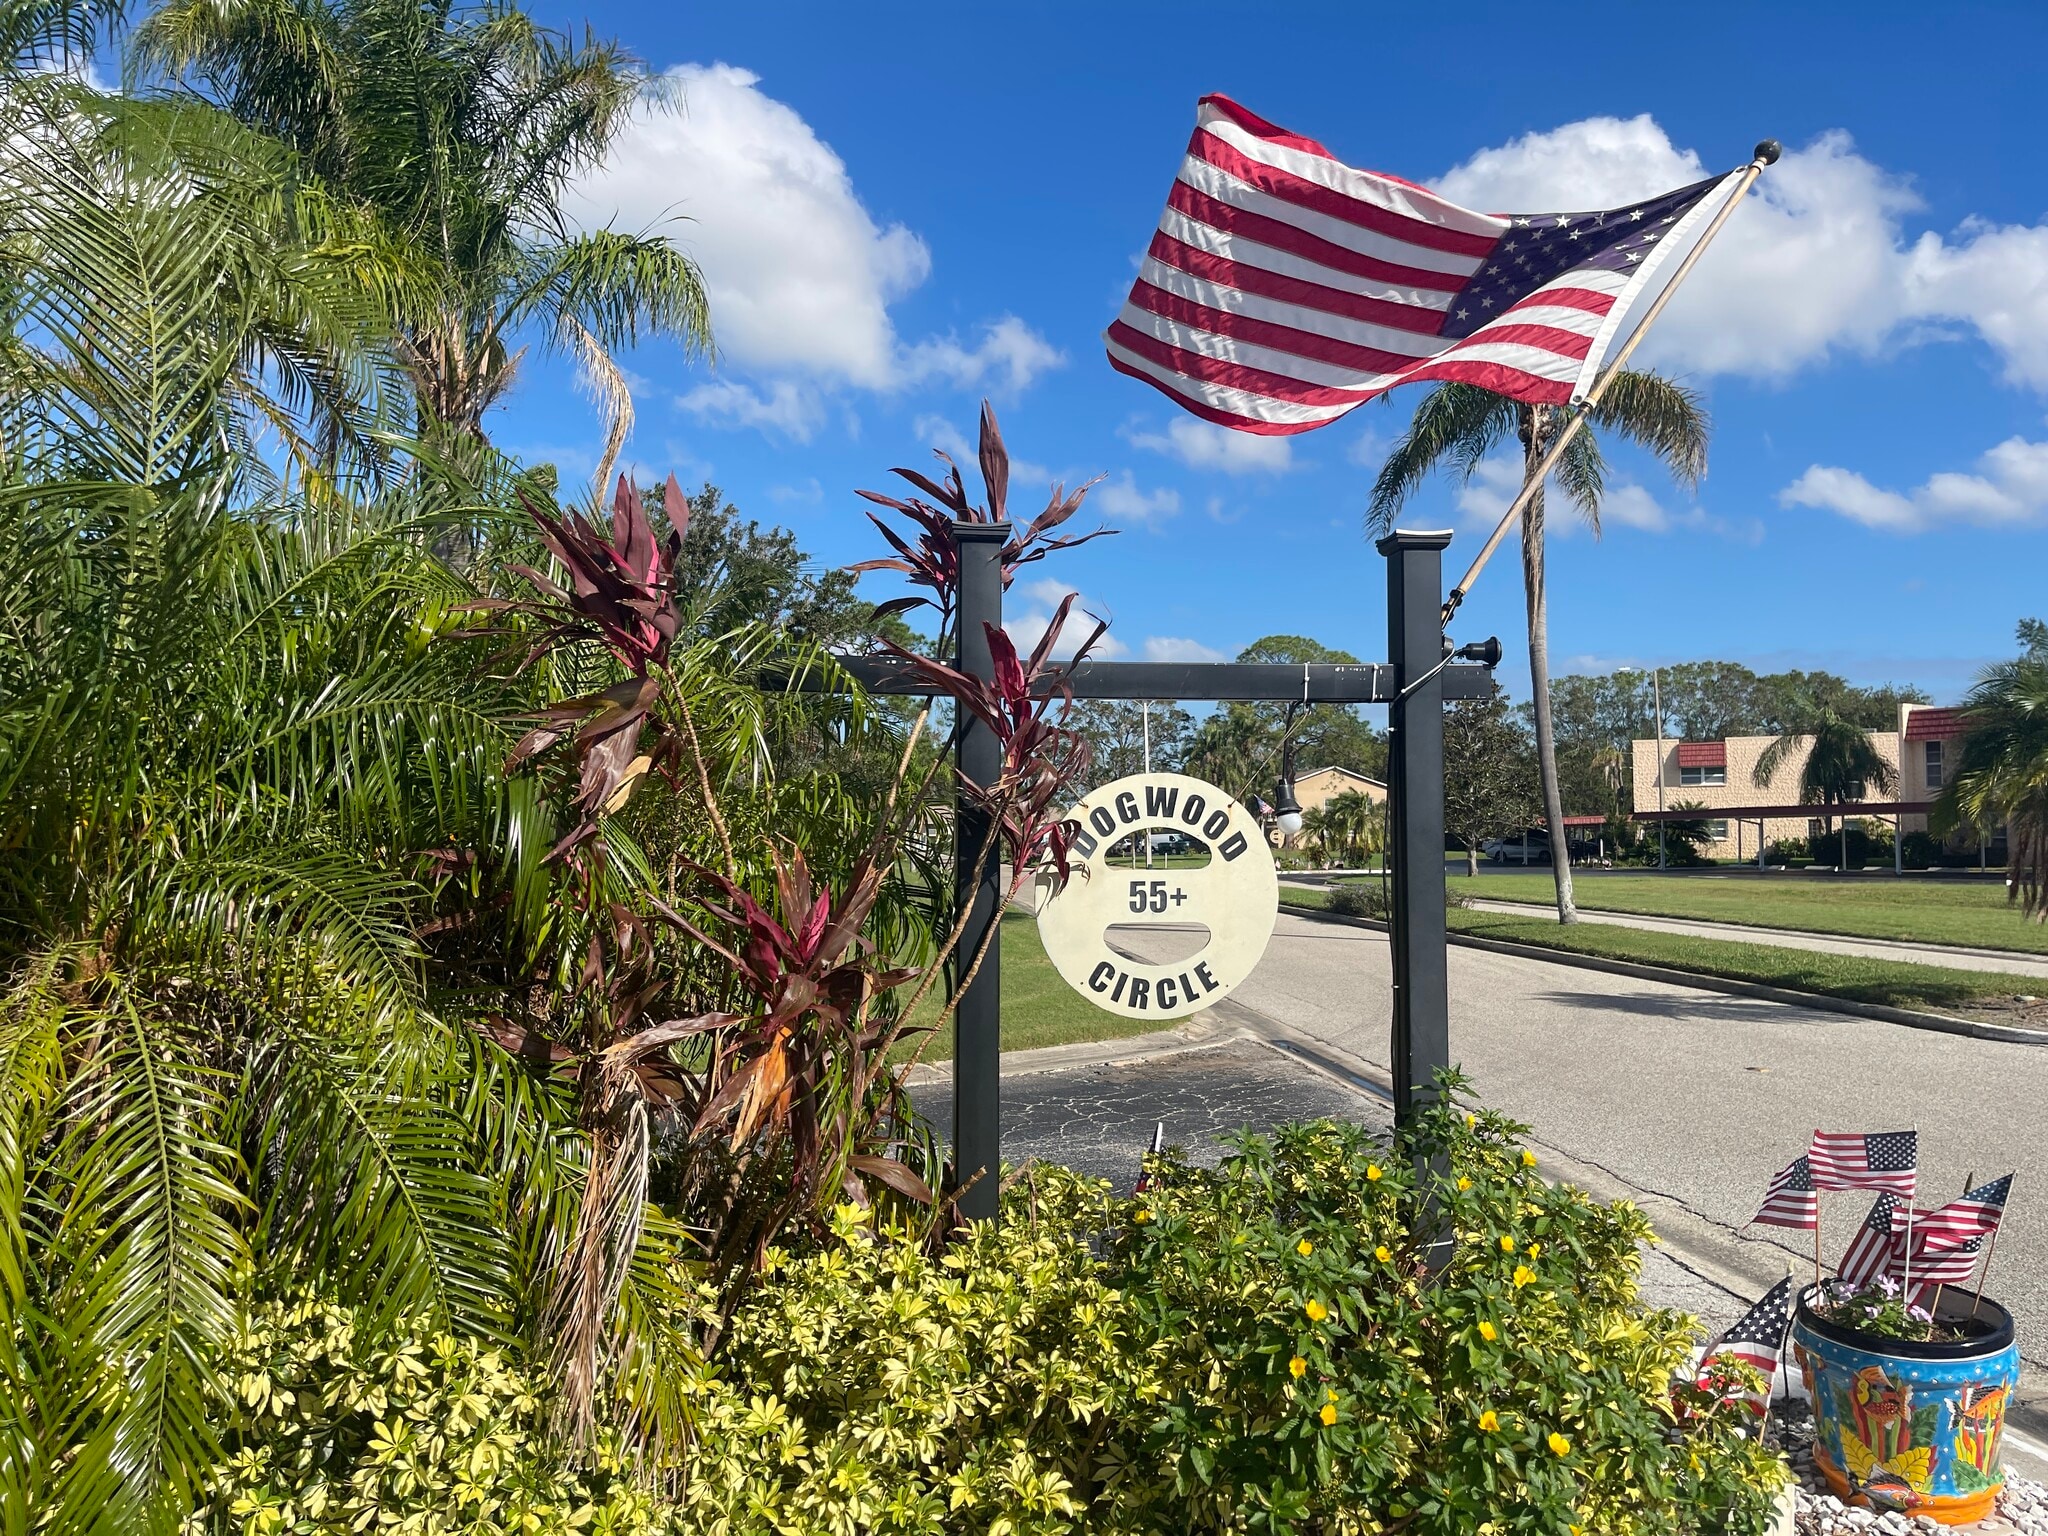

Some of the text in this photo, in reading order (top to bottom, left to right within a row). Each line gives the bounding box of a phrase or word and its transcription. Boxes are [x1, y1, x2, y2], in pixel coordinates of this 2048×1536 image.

[1072, 786, 1248, 862] DOGWOOD
[1128, 880, 1188, 914] 55+
[1088, 960, 1220, 1010] CIRCLE
